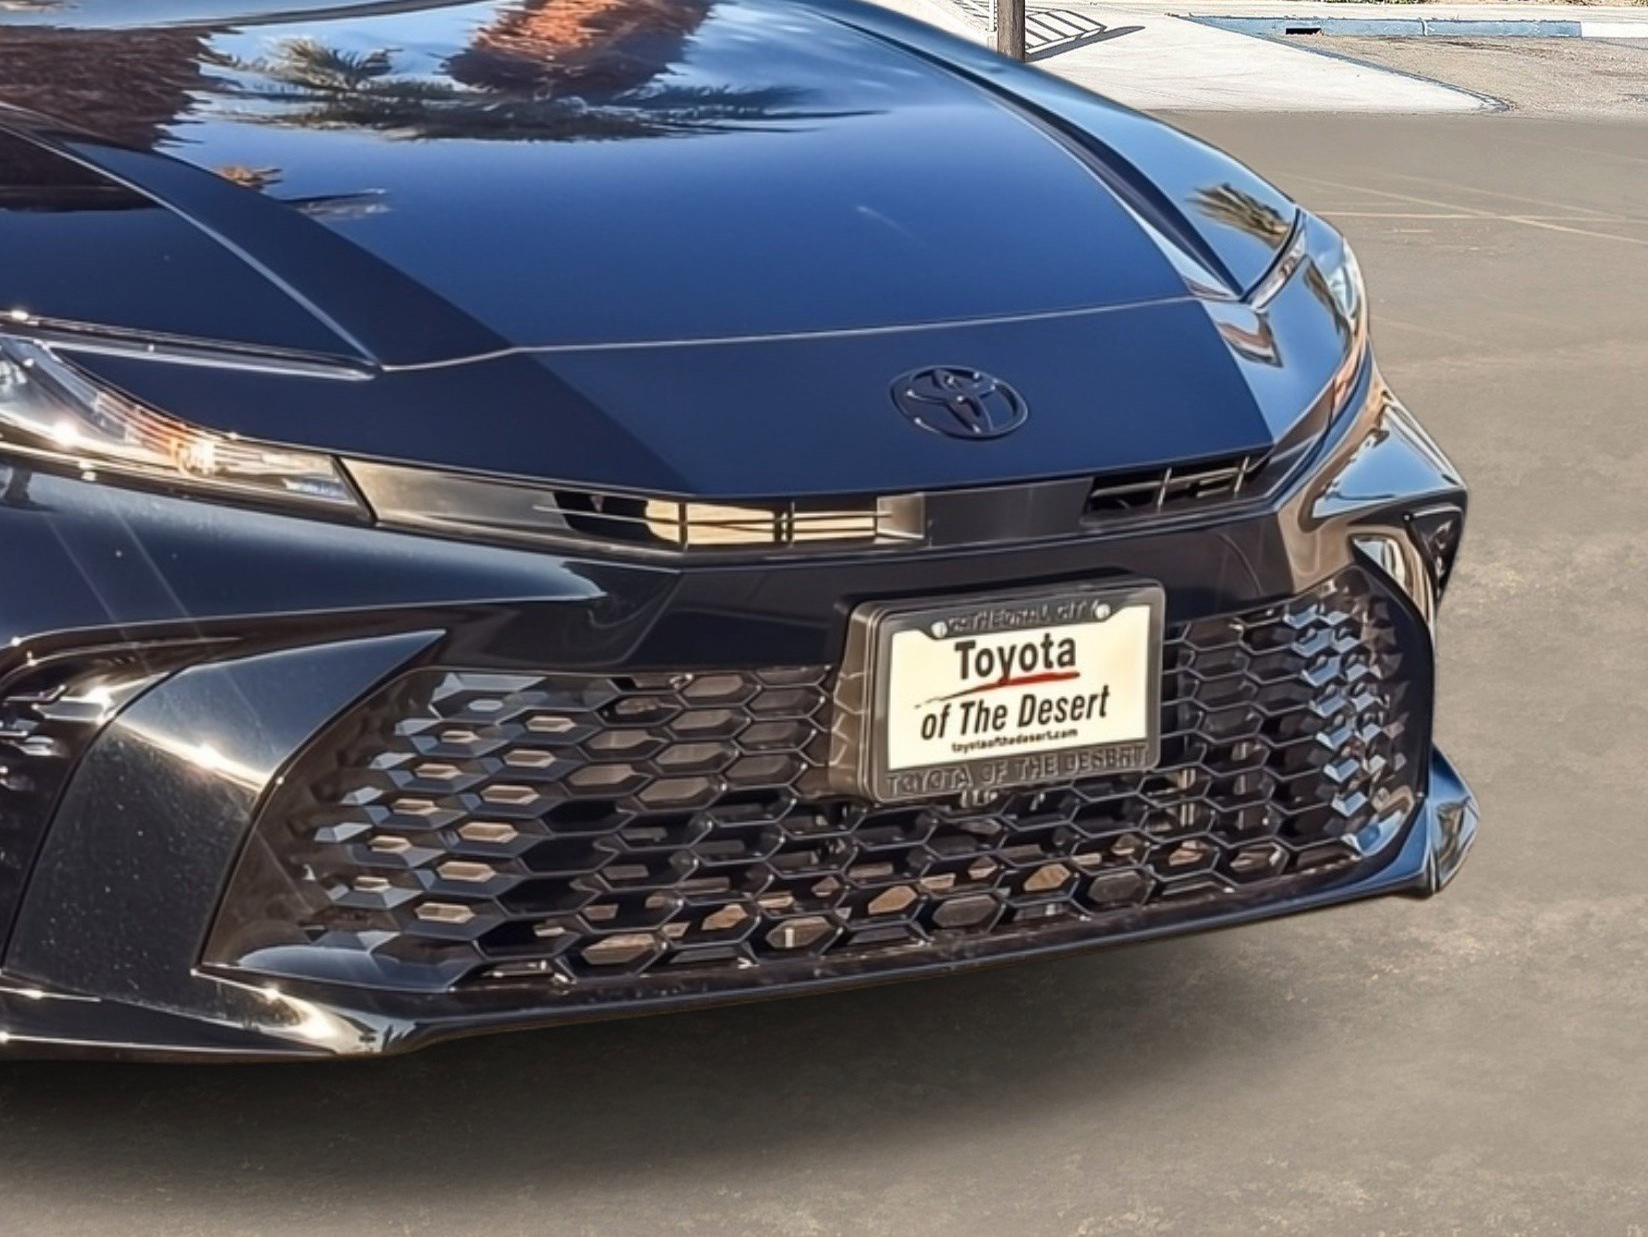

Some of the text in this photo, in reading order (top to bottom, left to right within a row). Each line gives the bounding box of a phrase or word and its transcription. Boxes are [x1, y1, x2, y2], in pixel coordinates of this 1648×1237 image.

[954, 632, 1076, 683] Toyota
[920, 684, 1110, 740] of The Desert
